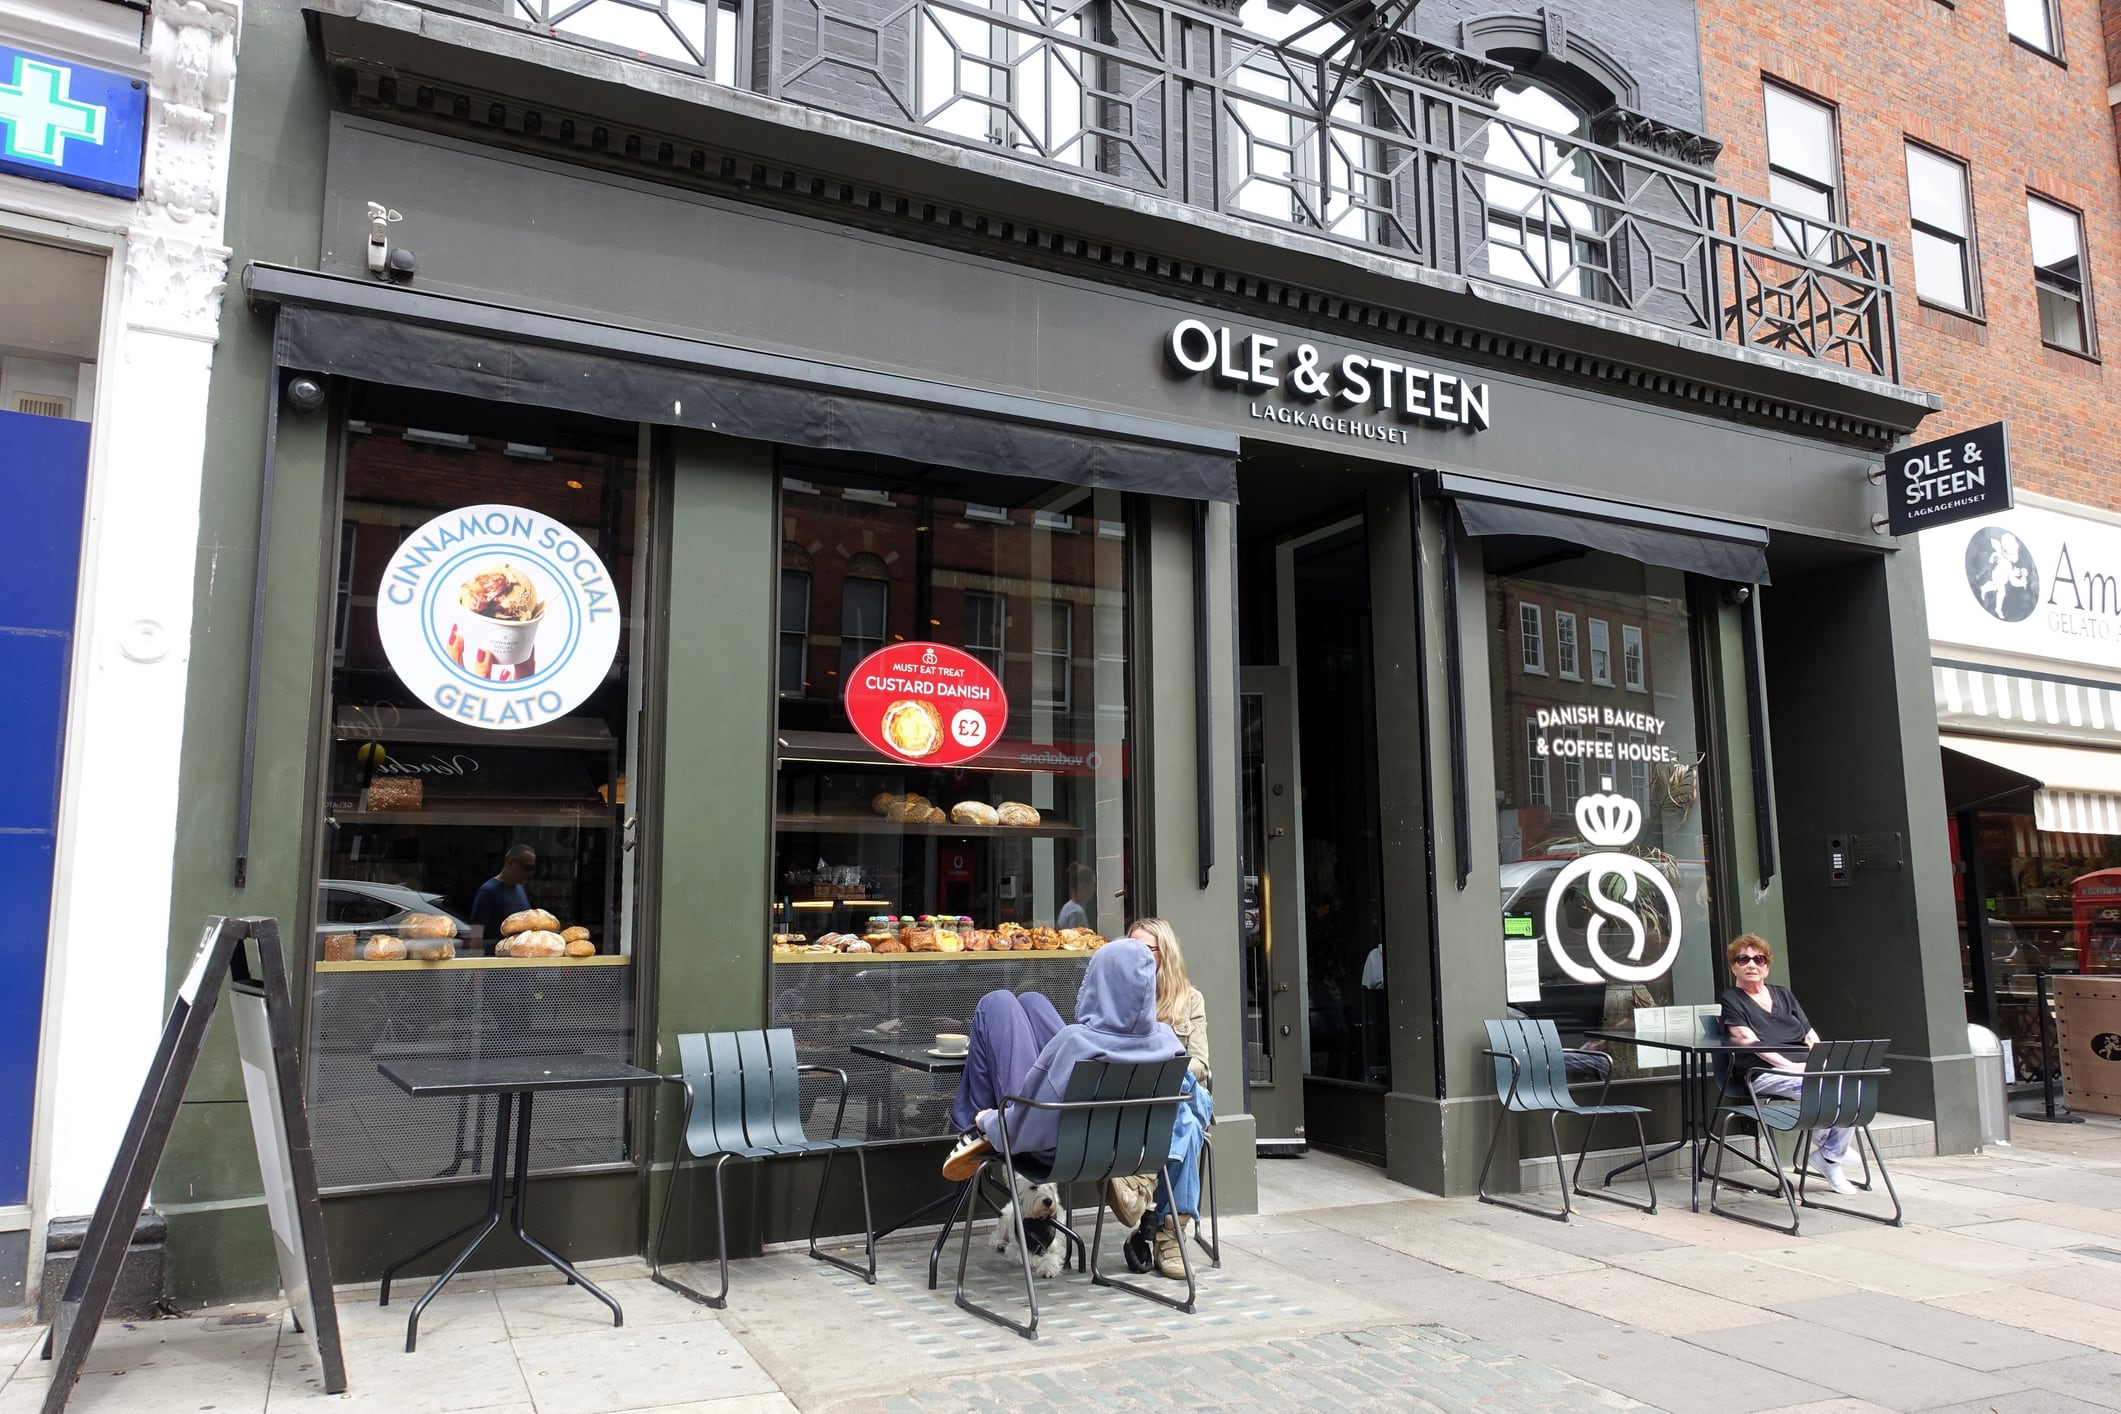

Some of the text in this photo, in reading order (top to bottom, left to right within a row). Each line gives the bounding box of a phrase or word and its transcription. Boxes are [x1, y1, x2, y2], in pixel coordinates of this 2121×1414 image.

[1172, 318, 1490, 430] OLE & STEEN
[1251, 402, 1410, 445] LAGKAGEHUSET
[1903, 442, 1983, 480] OLE &
[1905, 466, 1986, 505] STEEN
[1907, 493, 1986, 519] LAGKAGEHUSET
[387, 512, 613, 623] CINNAMON SOCIAL
[2047, 611, 2111, 640] GELATO
[893, 662, 965, 678] MUST EAT TREAT
[865, 675, 990, 700] CUSTARD DANISH
[434, 684, 562, 725] GELATO
[958, 719, 980, 737] £2
[1536, 706, 1666, 736] DANISH BAKERY
[1536, 738, 1670, 763] & COFFEE HOUSE
